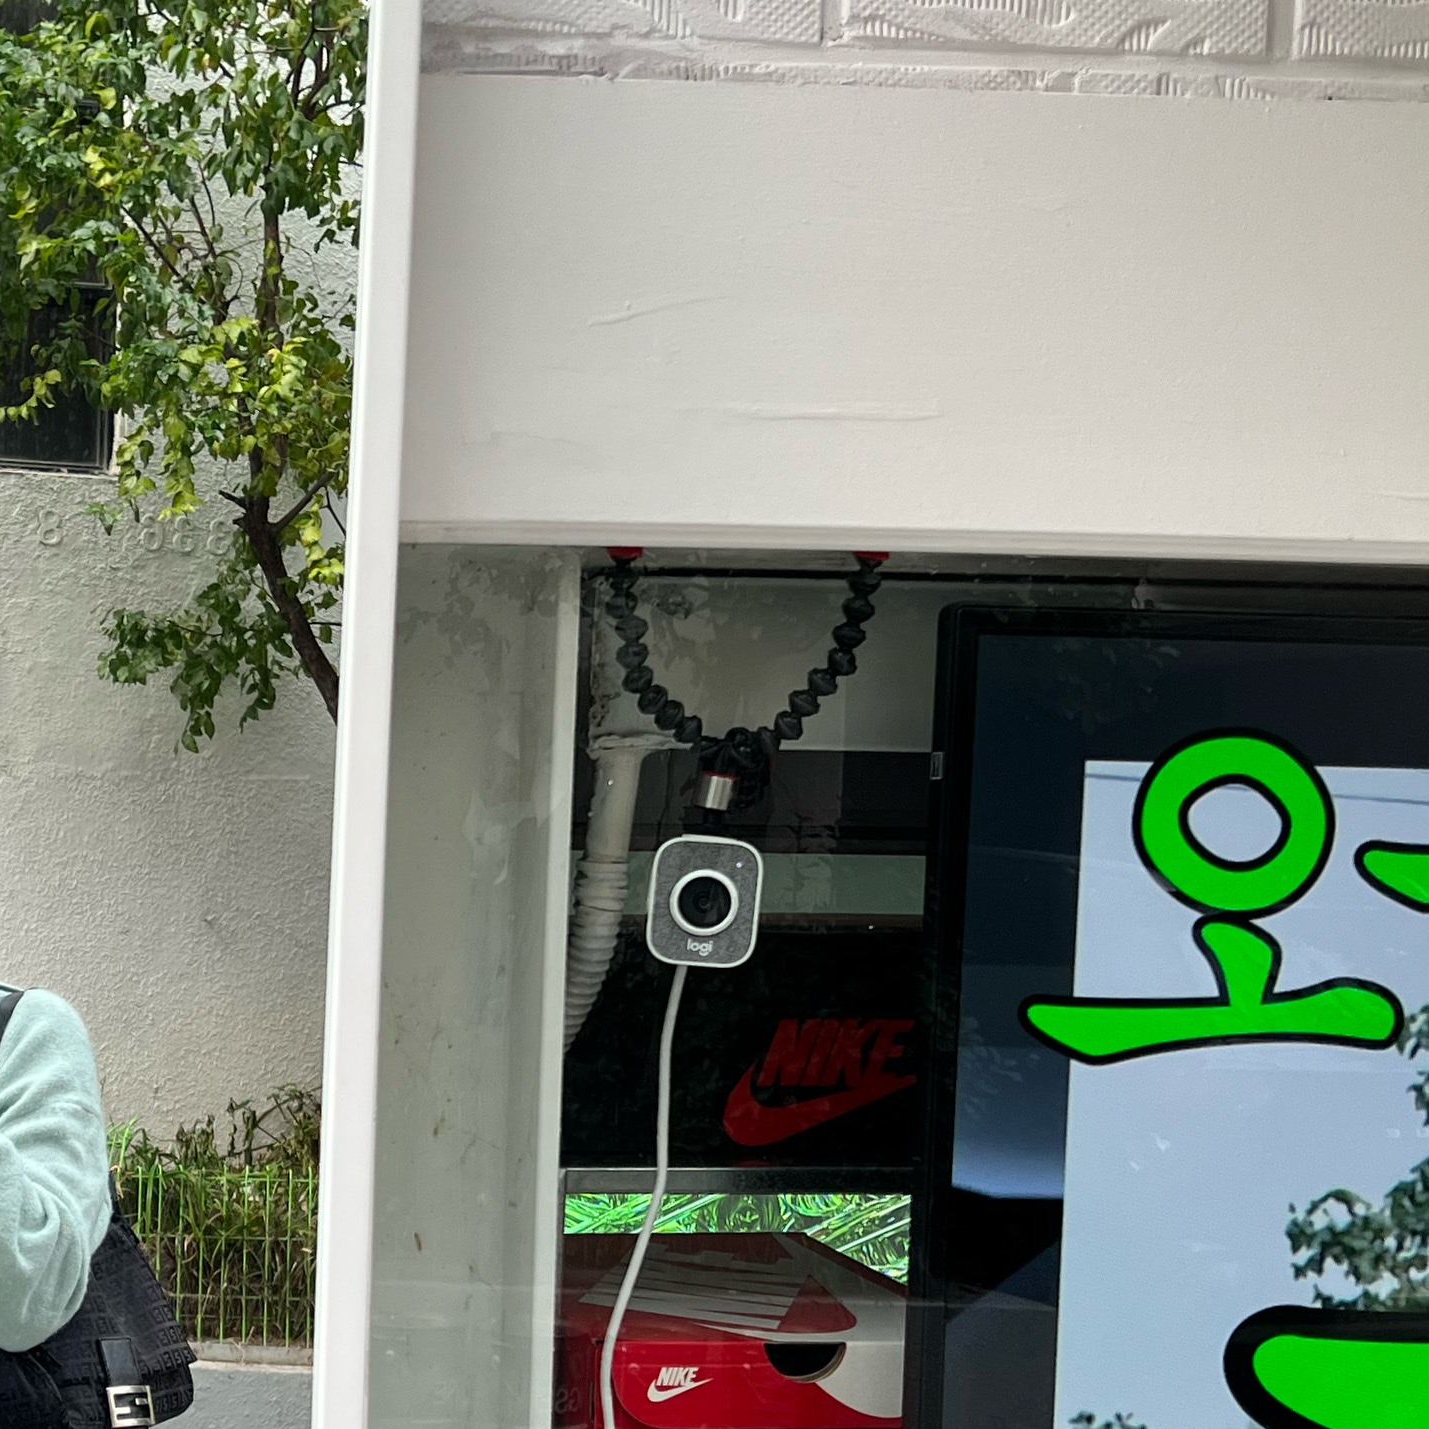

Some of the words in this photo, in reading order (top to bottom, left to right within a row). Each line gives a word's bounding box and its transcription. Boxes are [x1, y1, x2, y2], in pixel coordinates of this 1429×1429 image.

[687, 939, 714, 956] logi
[757, 1018, 914, 1088] NIKE
[656, 1367, 699, 1386] NIKE
